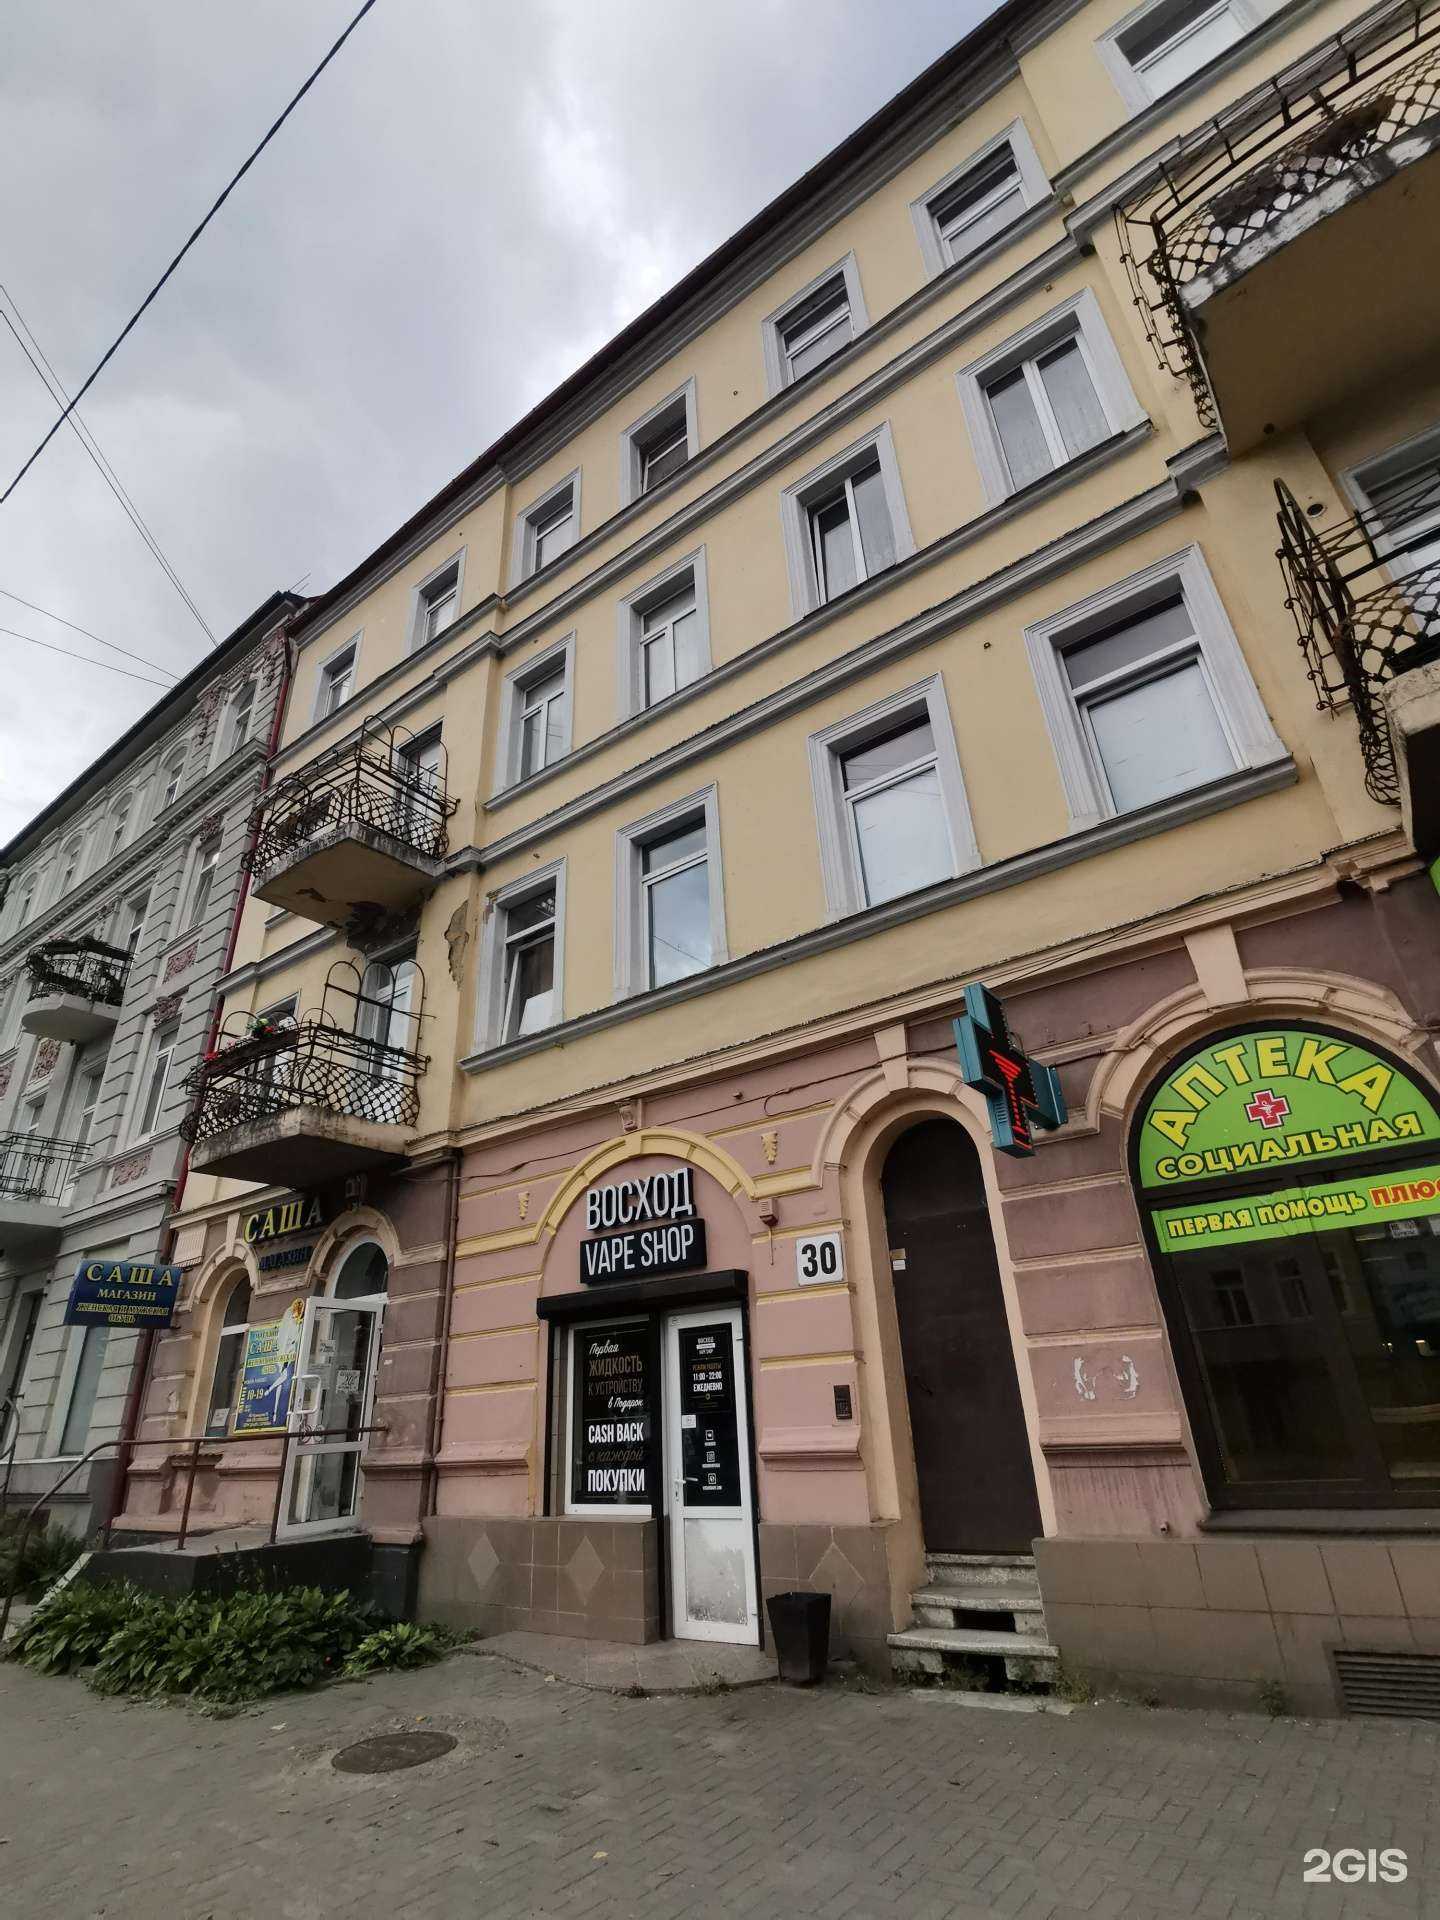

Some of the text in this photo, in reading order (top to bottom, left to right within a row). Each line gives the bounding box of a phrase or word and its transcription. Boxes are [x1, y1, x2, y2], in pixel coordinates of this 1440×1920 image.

[1149, 1035, 1396, 1150] АПТЕКА
[1155, 1111, 1426, 1180] СОЦИАЛЬНАЯ
[586, 1167, 695, 1231] ВОСХОД
[1166, 1179, 1440, 1239] ПЕРВАЯ ПОМОЩЬ ПЛЮ
[244, 1197, 323, 1244] САША
[585, 1224, 694, 1276] VAPE SHOP
[801, 1241, 837, 1278] 30
[86, 1263, 173, 1286] САША
[97, 1288, 157, 1300] МАГАЗИН
[589, 1339, 620, 1357] Первая
[589, 1355, 643, 1377] ЖИДКОСТЬ
[693, 1372, 705, 1381] 11:00
[709, 1371, 722, 1380] 22:00
[588, 1377, 643, 1396] К УСТРОЙСТВУ
[693, 1381, 723, 1392] ЕЖЕДНЕВНО
[607, 1396, 614, 1408] в
[588, 1422, 644, 1444] CASH BACK
[587, 1468, 645, 1492] ПОКУПКИ
